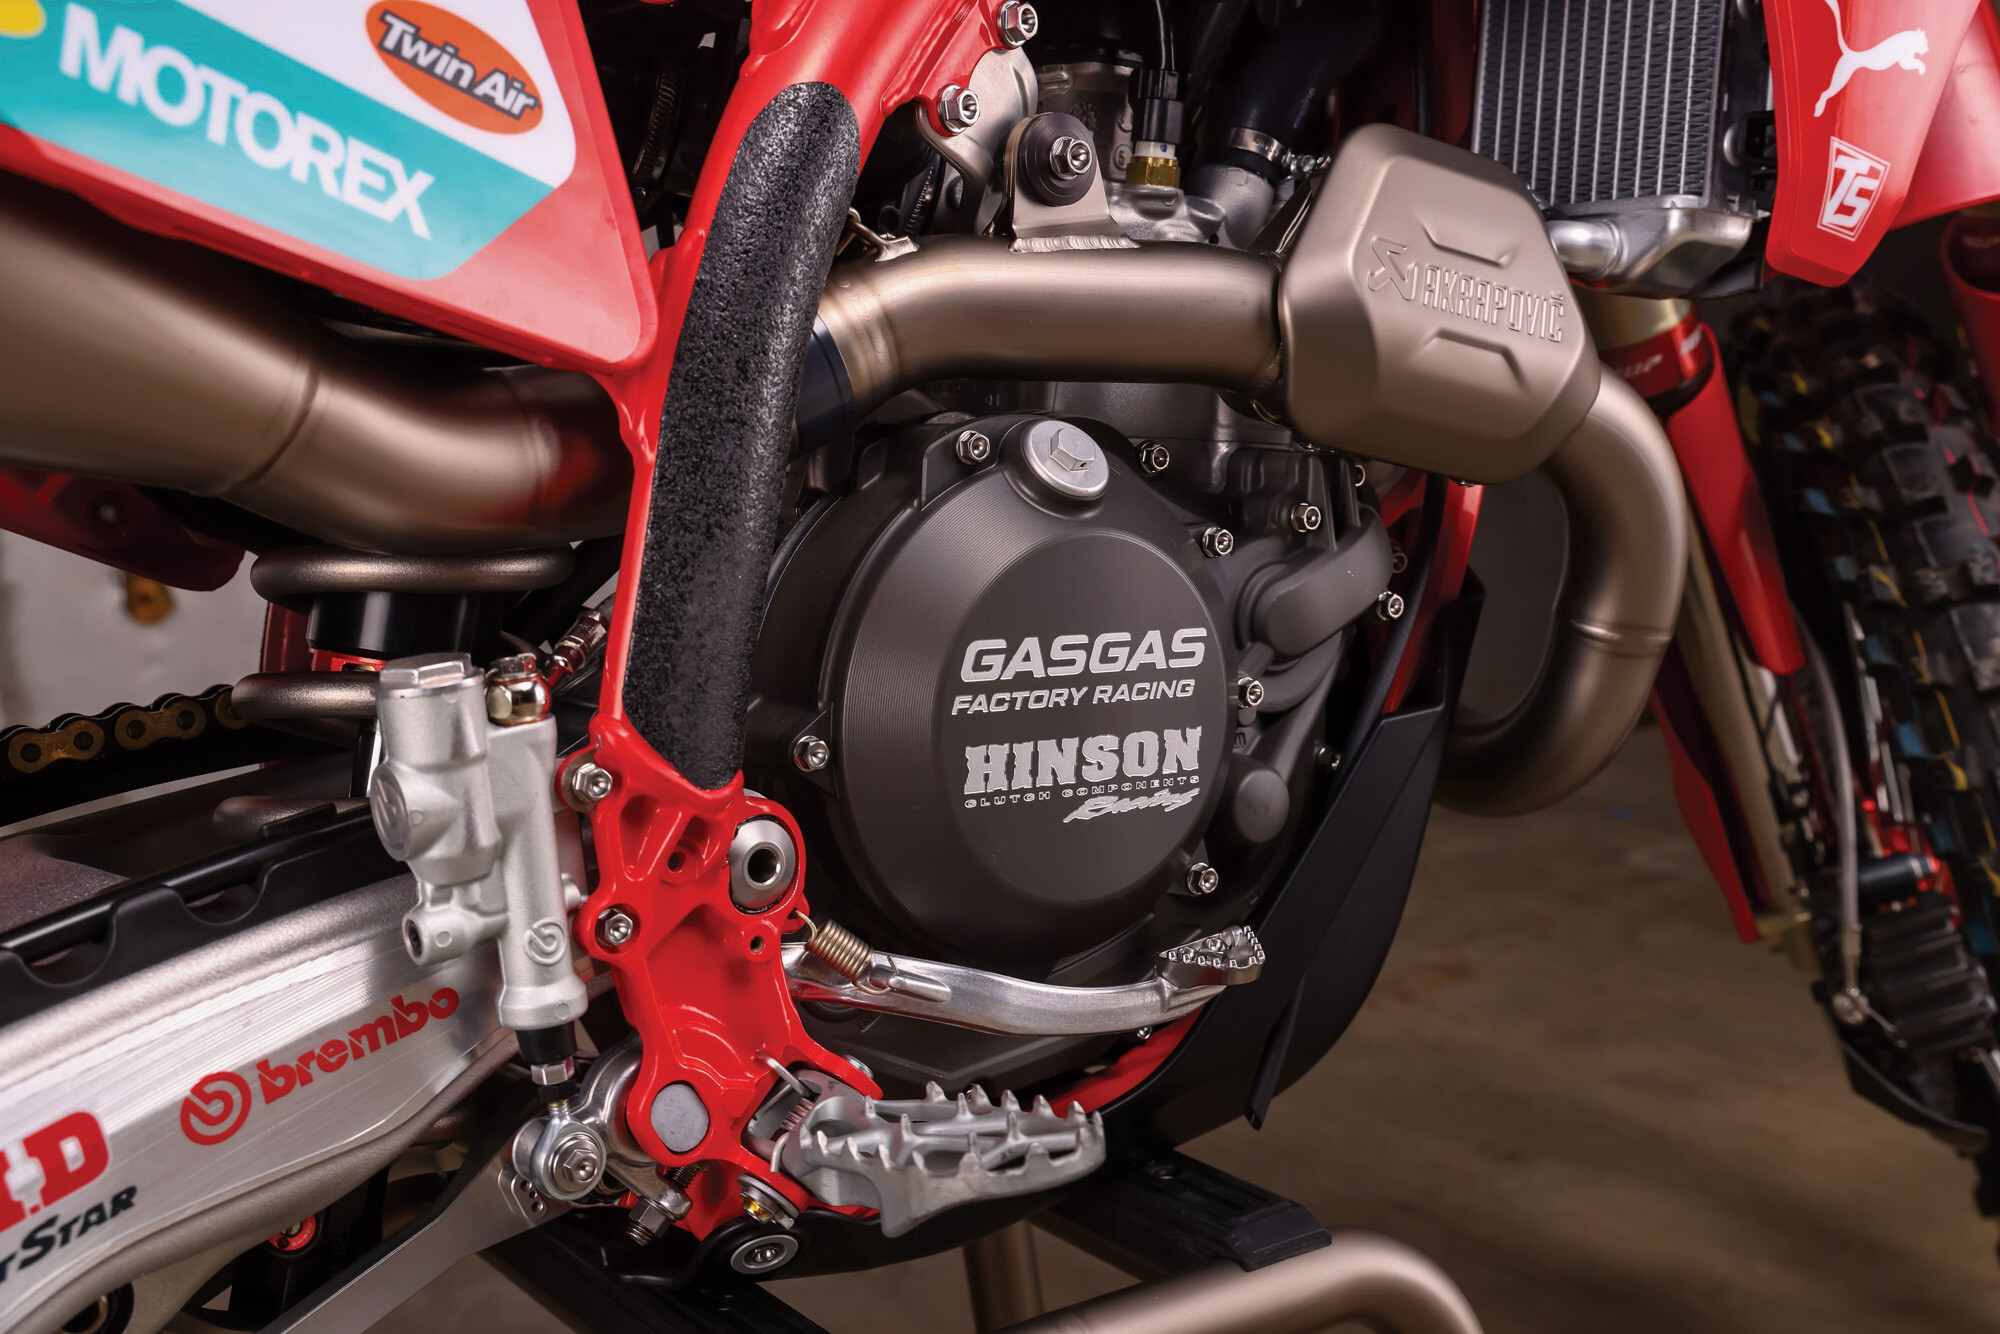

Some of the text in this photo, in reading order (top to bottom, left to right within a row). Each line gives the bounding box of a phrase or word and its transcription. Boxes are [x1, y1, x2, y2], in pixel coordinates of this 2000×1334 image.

[379, 10, 539, 119] Twin Air
[59, 4, 435, 240] MOTOREX
[1422, 264, 1564, 343] AKRAPOVIČ
[960, 627, 1208, 683] GASGAS
[951, 679, 1196, 716] FACTORY RACING
[963, 726, 1203, 795] HINSON
[964, 775, 1200, 809] CLUTCH COMPONENTS
[256, 987, 460, 1105] brembo
